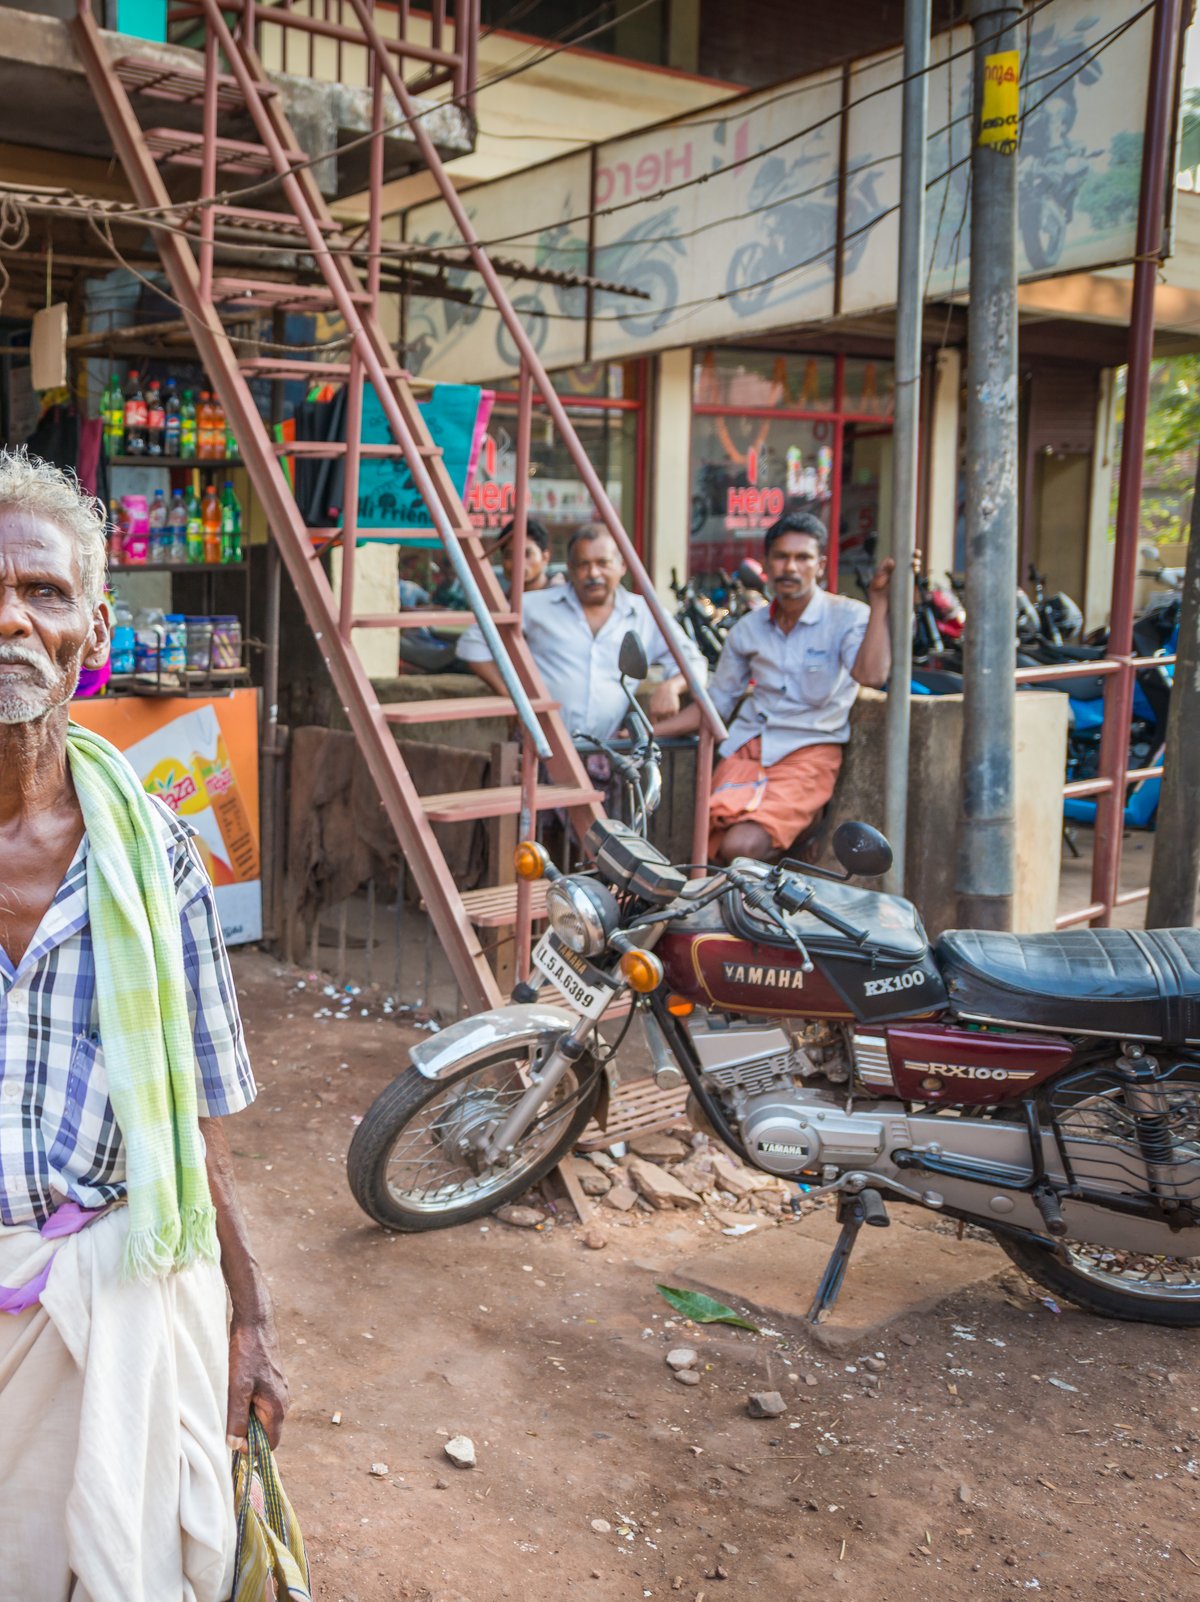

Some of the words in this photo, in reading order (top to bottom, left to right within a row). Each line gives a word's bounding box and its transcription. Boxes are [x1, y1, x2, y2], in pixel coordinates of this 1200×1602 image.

[467, 482, 532, 512] Her
[728, 487, 784, 514] Hero
[381, 502, 432, 525] Frien
[724, 965, 803, 990] YAMAHA
[863, 970, 925, 997] RX100
[928, 1062, 1008, 1081] RX100
[761, 1142, 802, 1156] YAMAHA
